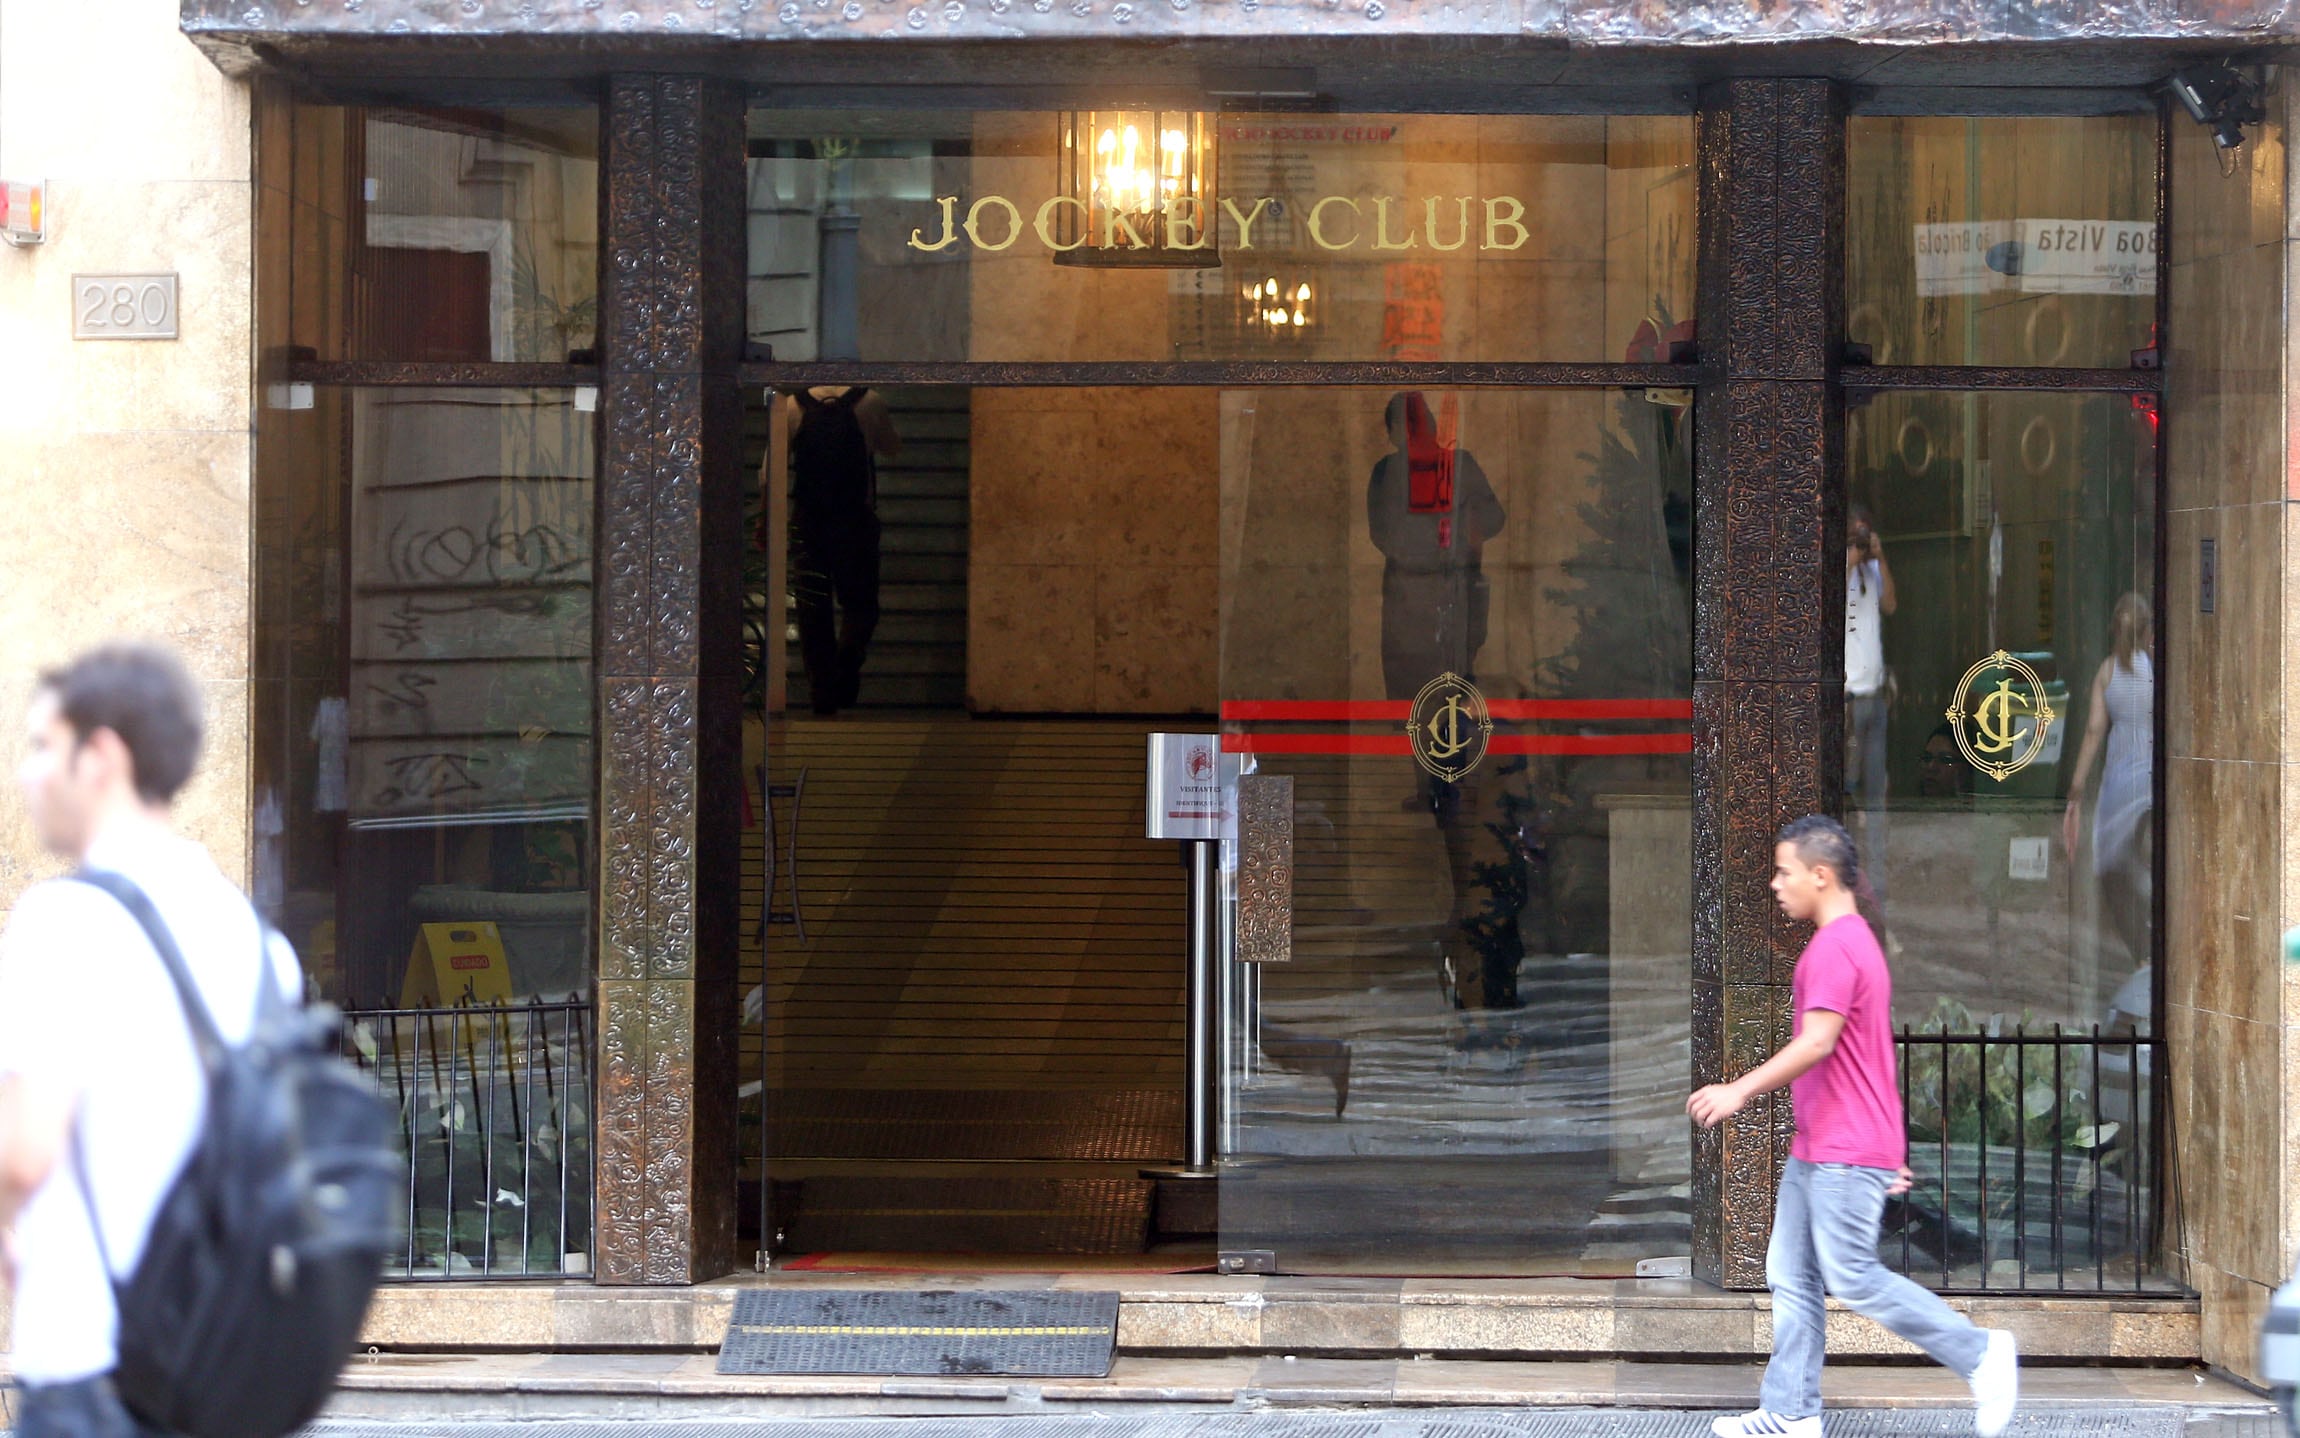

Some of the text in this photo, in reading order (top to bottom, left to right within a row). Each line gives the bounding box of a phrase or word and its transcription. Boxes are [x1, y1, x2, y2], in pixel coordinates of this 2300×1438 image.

[907, 195, 1275, 251] JOCKEY
[1307, 195, 1530, 251] CLUB
[83, 283, 168, 327] 280
[1180, 785, 1222, 793] VISITANTES
[452, 957, 489, 969] CUIDADO
